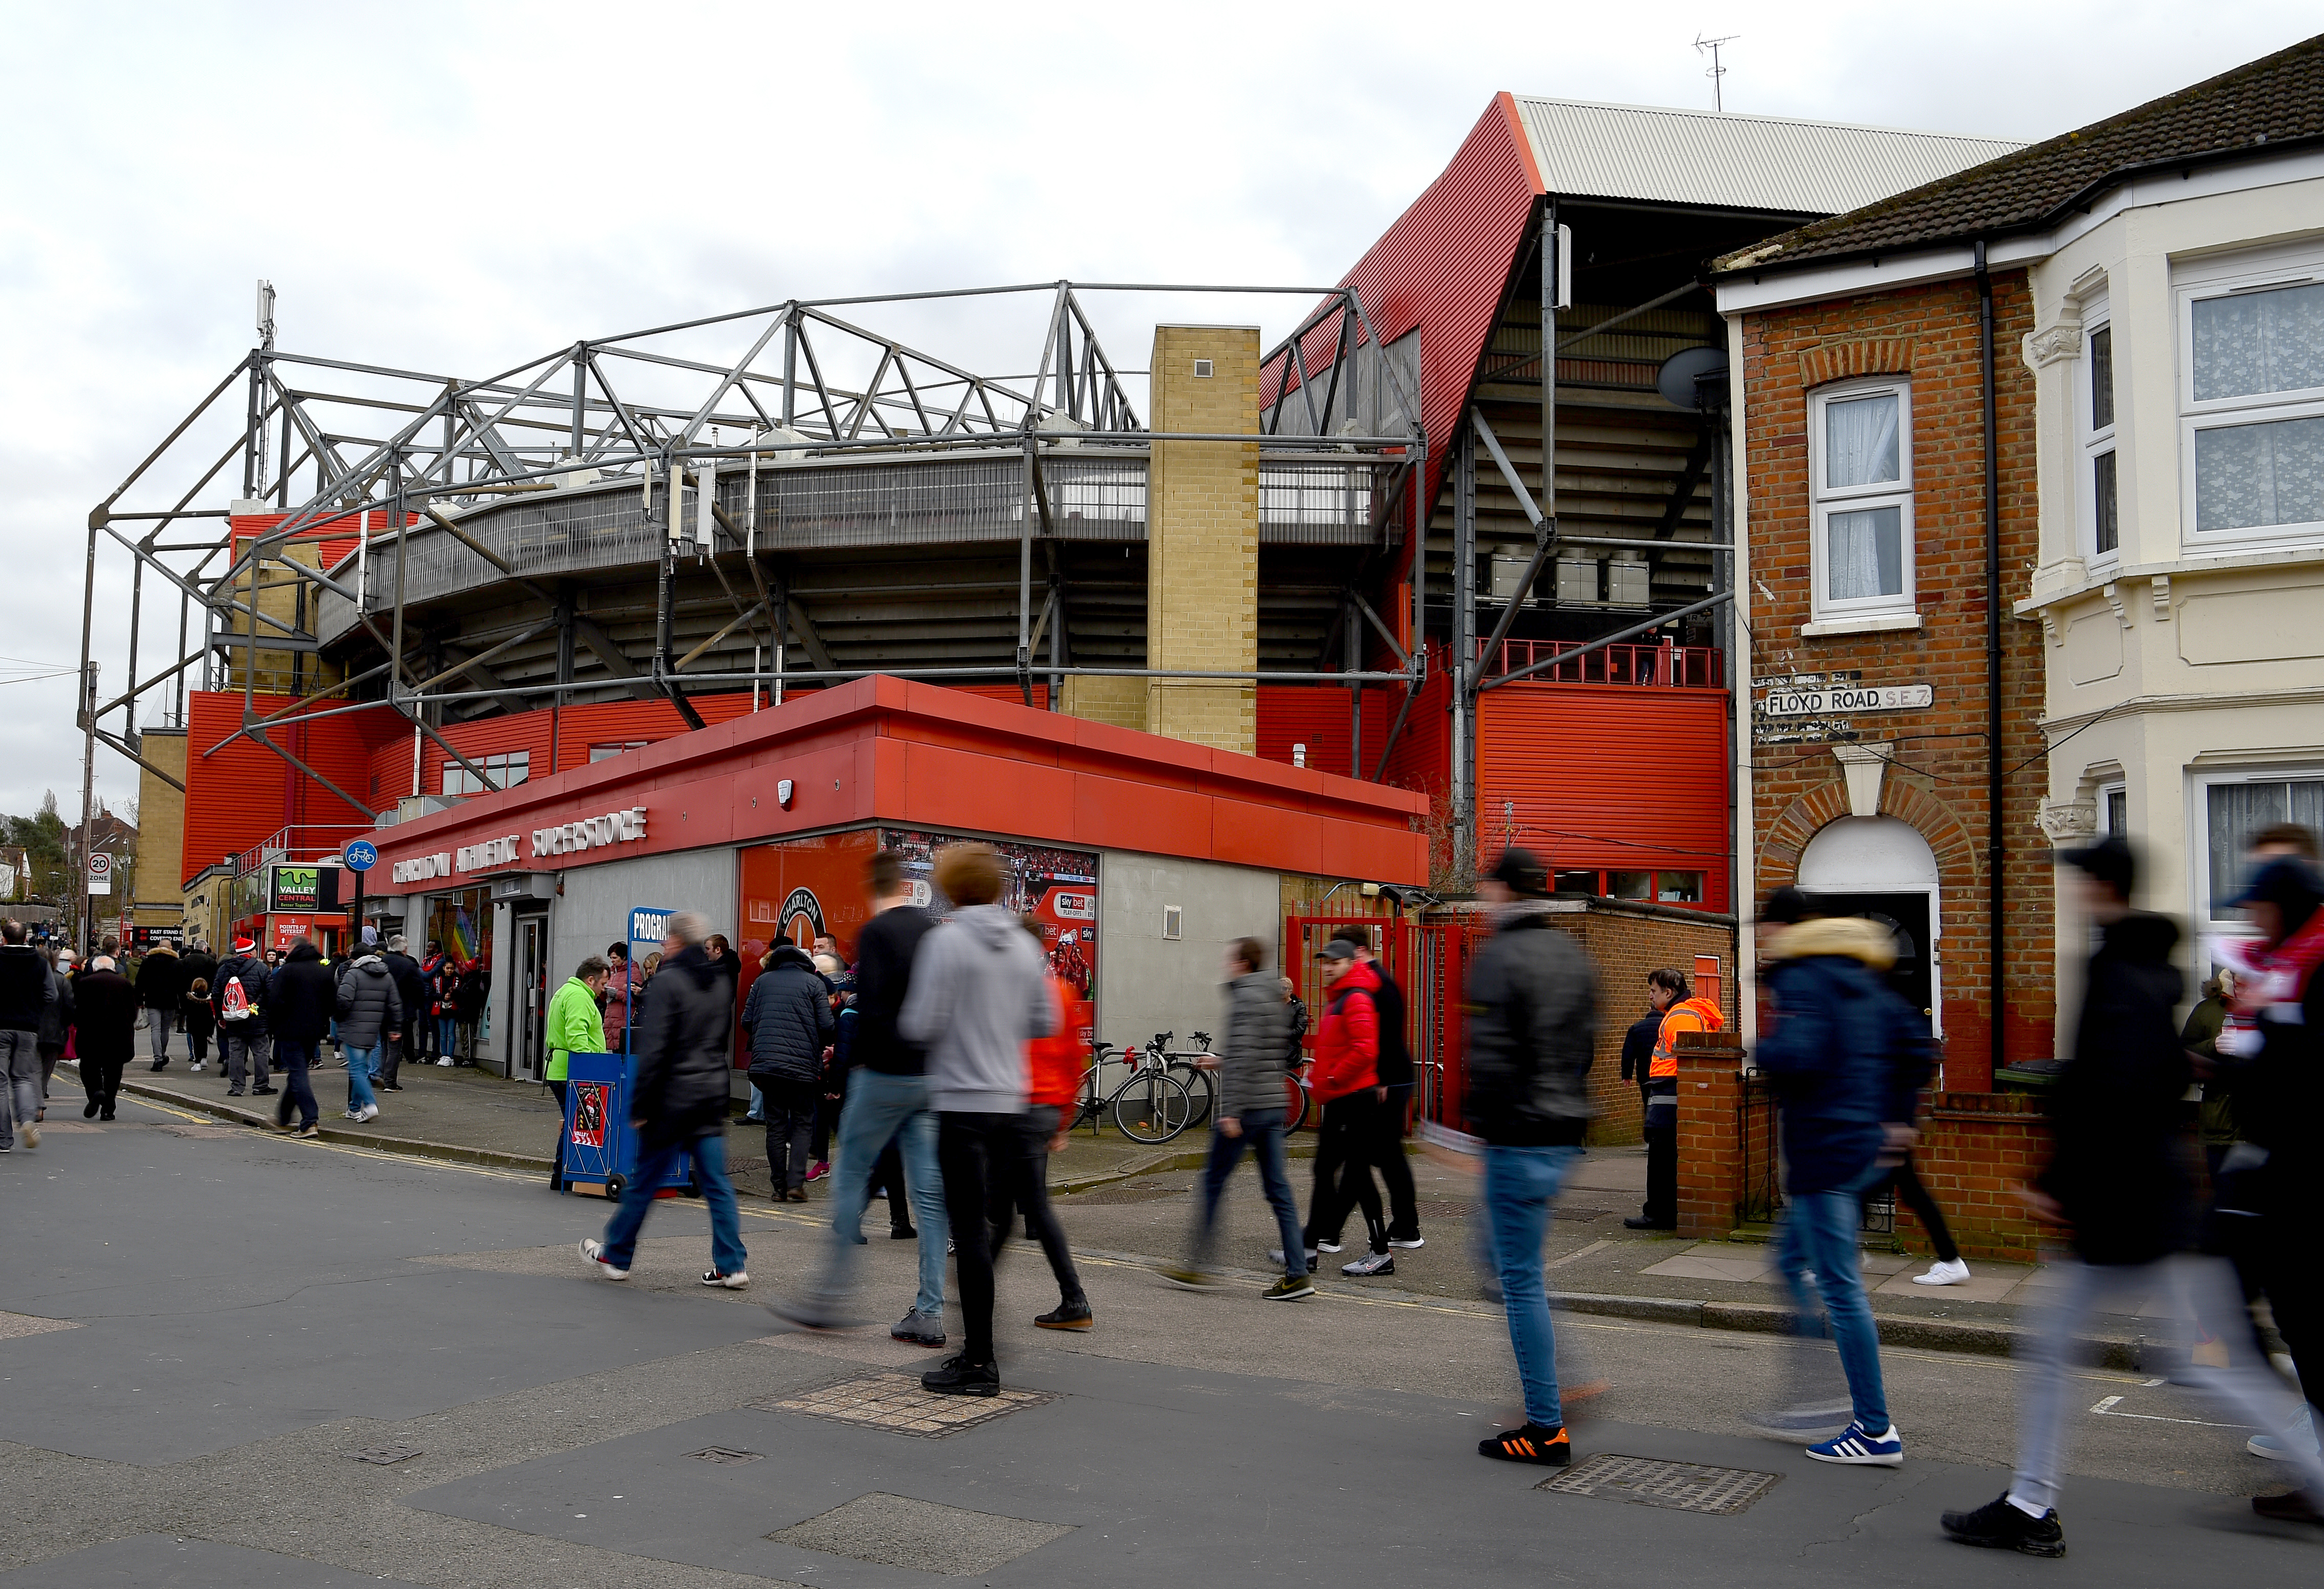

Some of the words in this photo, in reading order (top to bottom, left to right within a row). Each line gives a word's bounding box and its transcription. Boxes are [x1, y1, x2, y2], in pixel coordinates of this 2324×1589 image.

[1770, 694, 1822, 713] FLOYD
[393, 853, 450, 883] CHARLTON
[455, 835, 520, 872] ATHLETIC
[532, 807, 647, 857] SUPERSTORE
[93, 859, 106, 868] 20
[1061, 897, 1072, 908] sky
[1073, 898, 1084, 907] bet
[783, 894, 818, 924] CHARLTON
[1045, 924, 1056, 936] bet
[1083, 929, 1093, 940] sky
